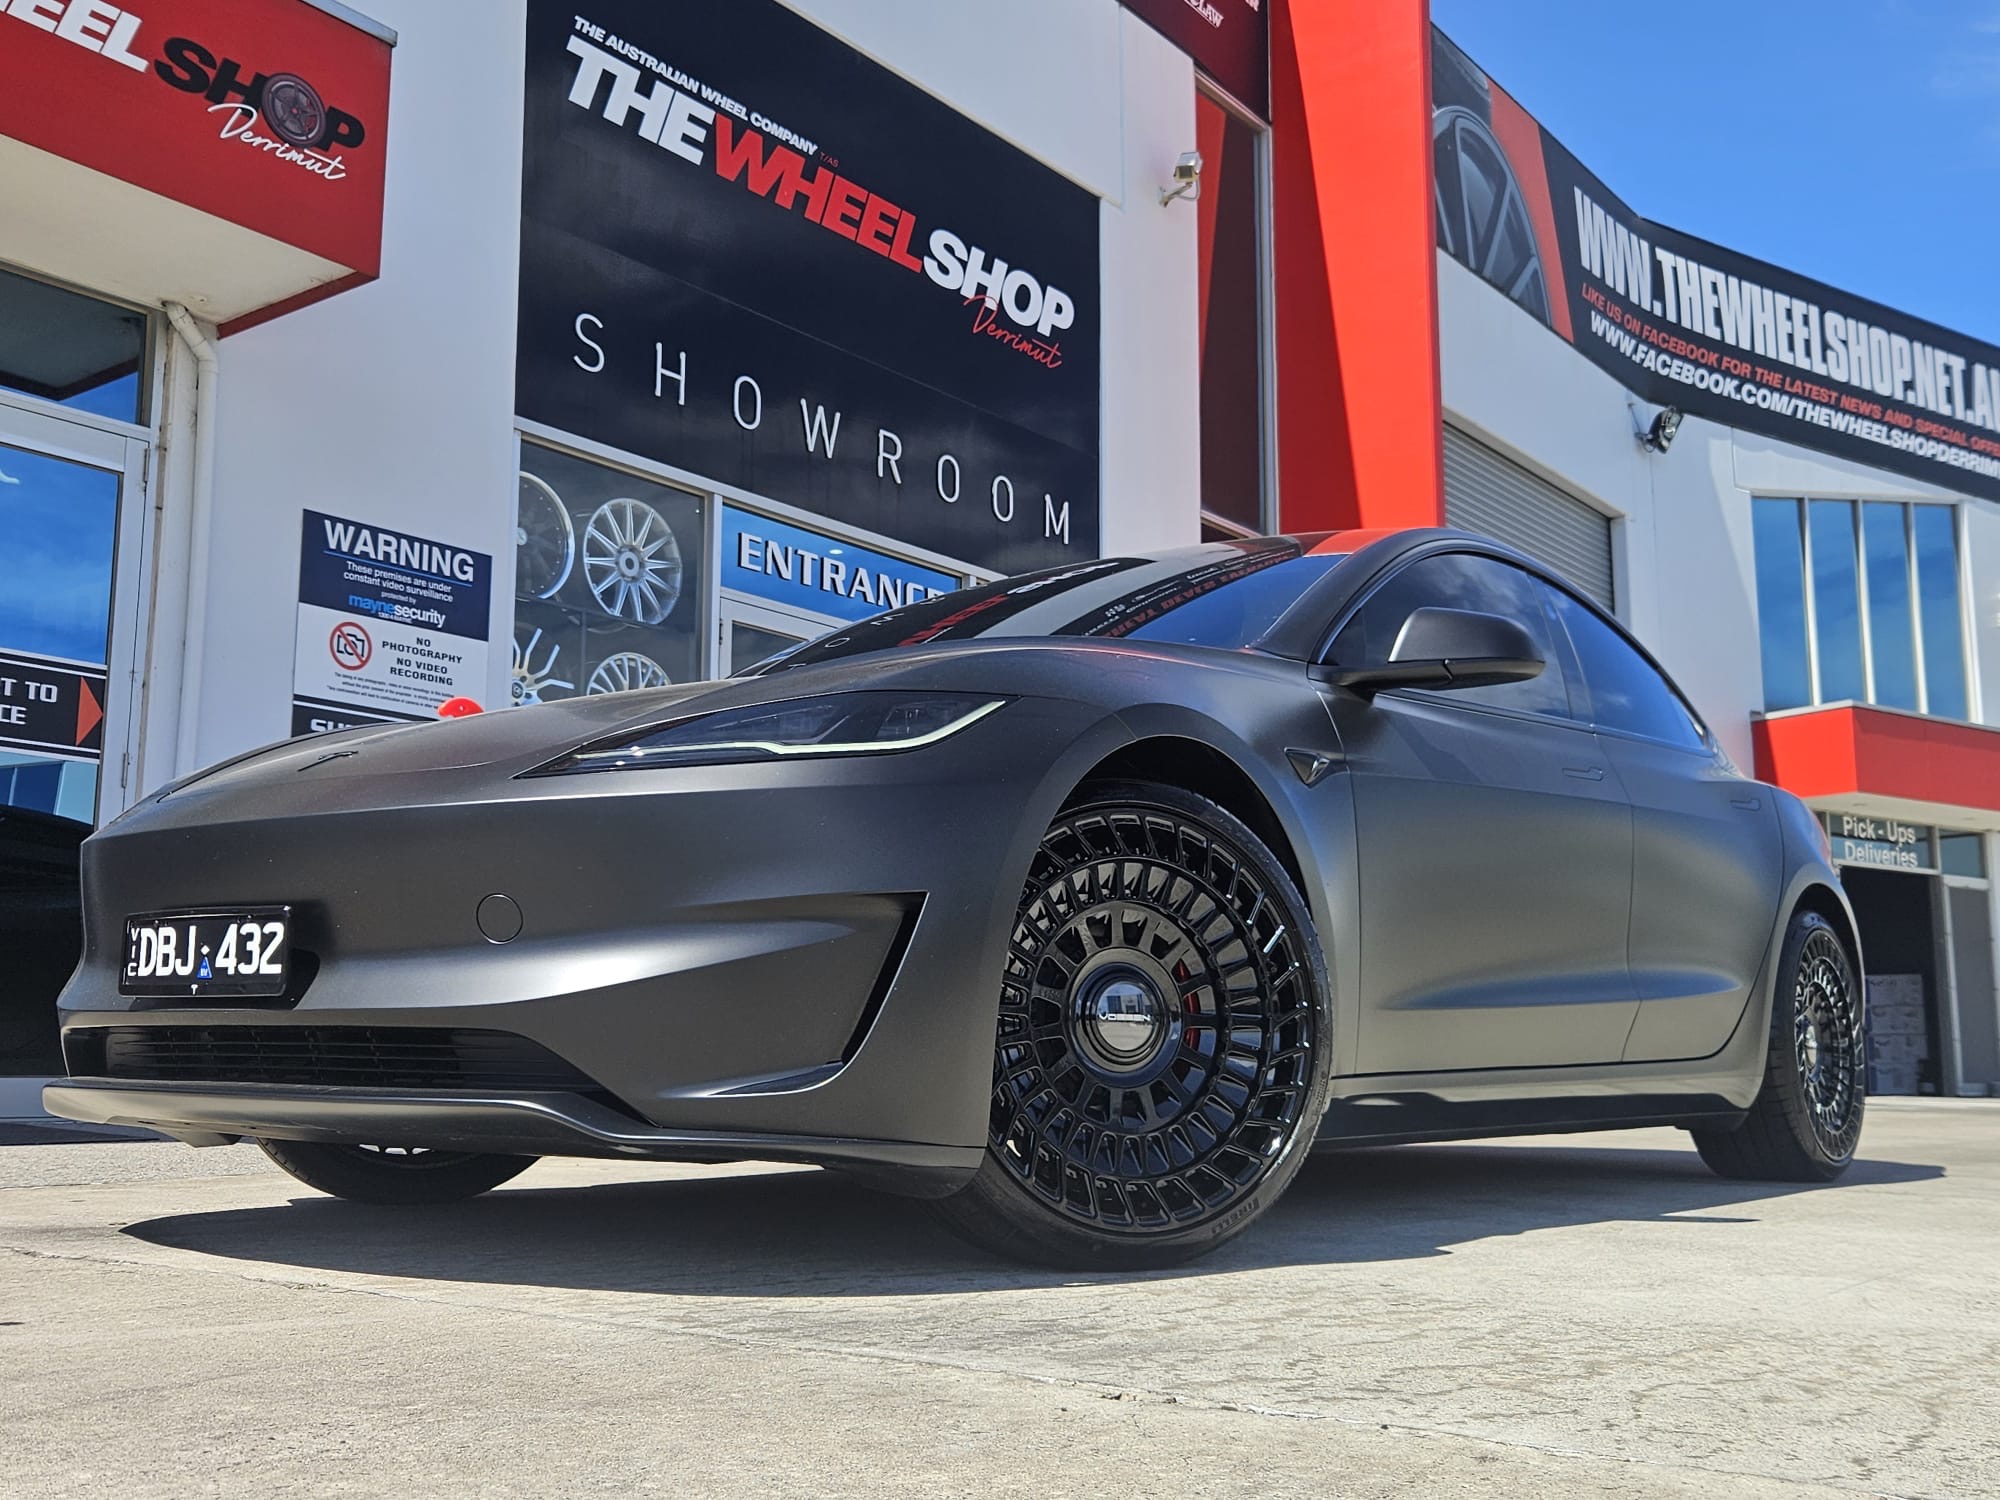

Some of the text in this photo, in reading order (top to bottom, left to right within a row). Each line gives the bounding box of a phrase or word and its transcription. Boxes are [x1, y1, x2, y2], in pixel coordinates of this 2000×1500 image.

[0, 0, 365, 151] EEL SHOP
[574, 15, 606, 42] THE
[606, 35, 699, 92] AUSTRALIAN
[701, 84, 749, 121] WHEEL
[750, 112, 818, 156] COMPANY
[207, 103, 346, 180] Derrimut
[566, 34, 1075, 337] THE WHEEL SHOP
[963, 295, 1063, 370] Derrimut
[1582, 283, 1605, 308] LIKE
[1606, 301, 1621, 320] US
[1624, 313, 1641, 333] ON
[1642, 324, 1719, 368] FACEBOOK
[1721, 356, 1752, 377] FOR
[1755, 367, 1783, 387] THE
[1785, 376, 1838, 405] LATEST
[1840, 394, 1882, 420] NEWS
[1883, 409, 1913, 428] AND
[1915, 418, 1968, 447] SPECIAL
[573, 313, 1070, 545] SHOWROOM
[324, 519, 474, 582] WARNING
[343, 571, 454, 602] constant video surveillance
[346, 560, 452, 593] These premises are under
[381, 640, 464, 664] PHOTOGRAPHY
[416, 637, 432, 648] NO
[389, 667, 454, 686] RECORDING
[396, 657, 448, 674] NO VIDEO
[25, 681, 58, 703] TO
[1842, 816, 1876, 839] Pick
[1886, 820, 1916, 847] Ups
[1844, 841, 1919, 868] Deliveries
[127, 928, 140, 976] VIC
